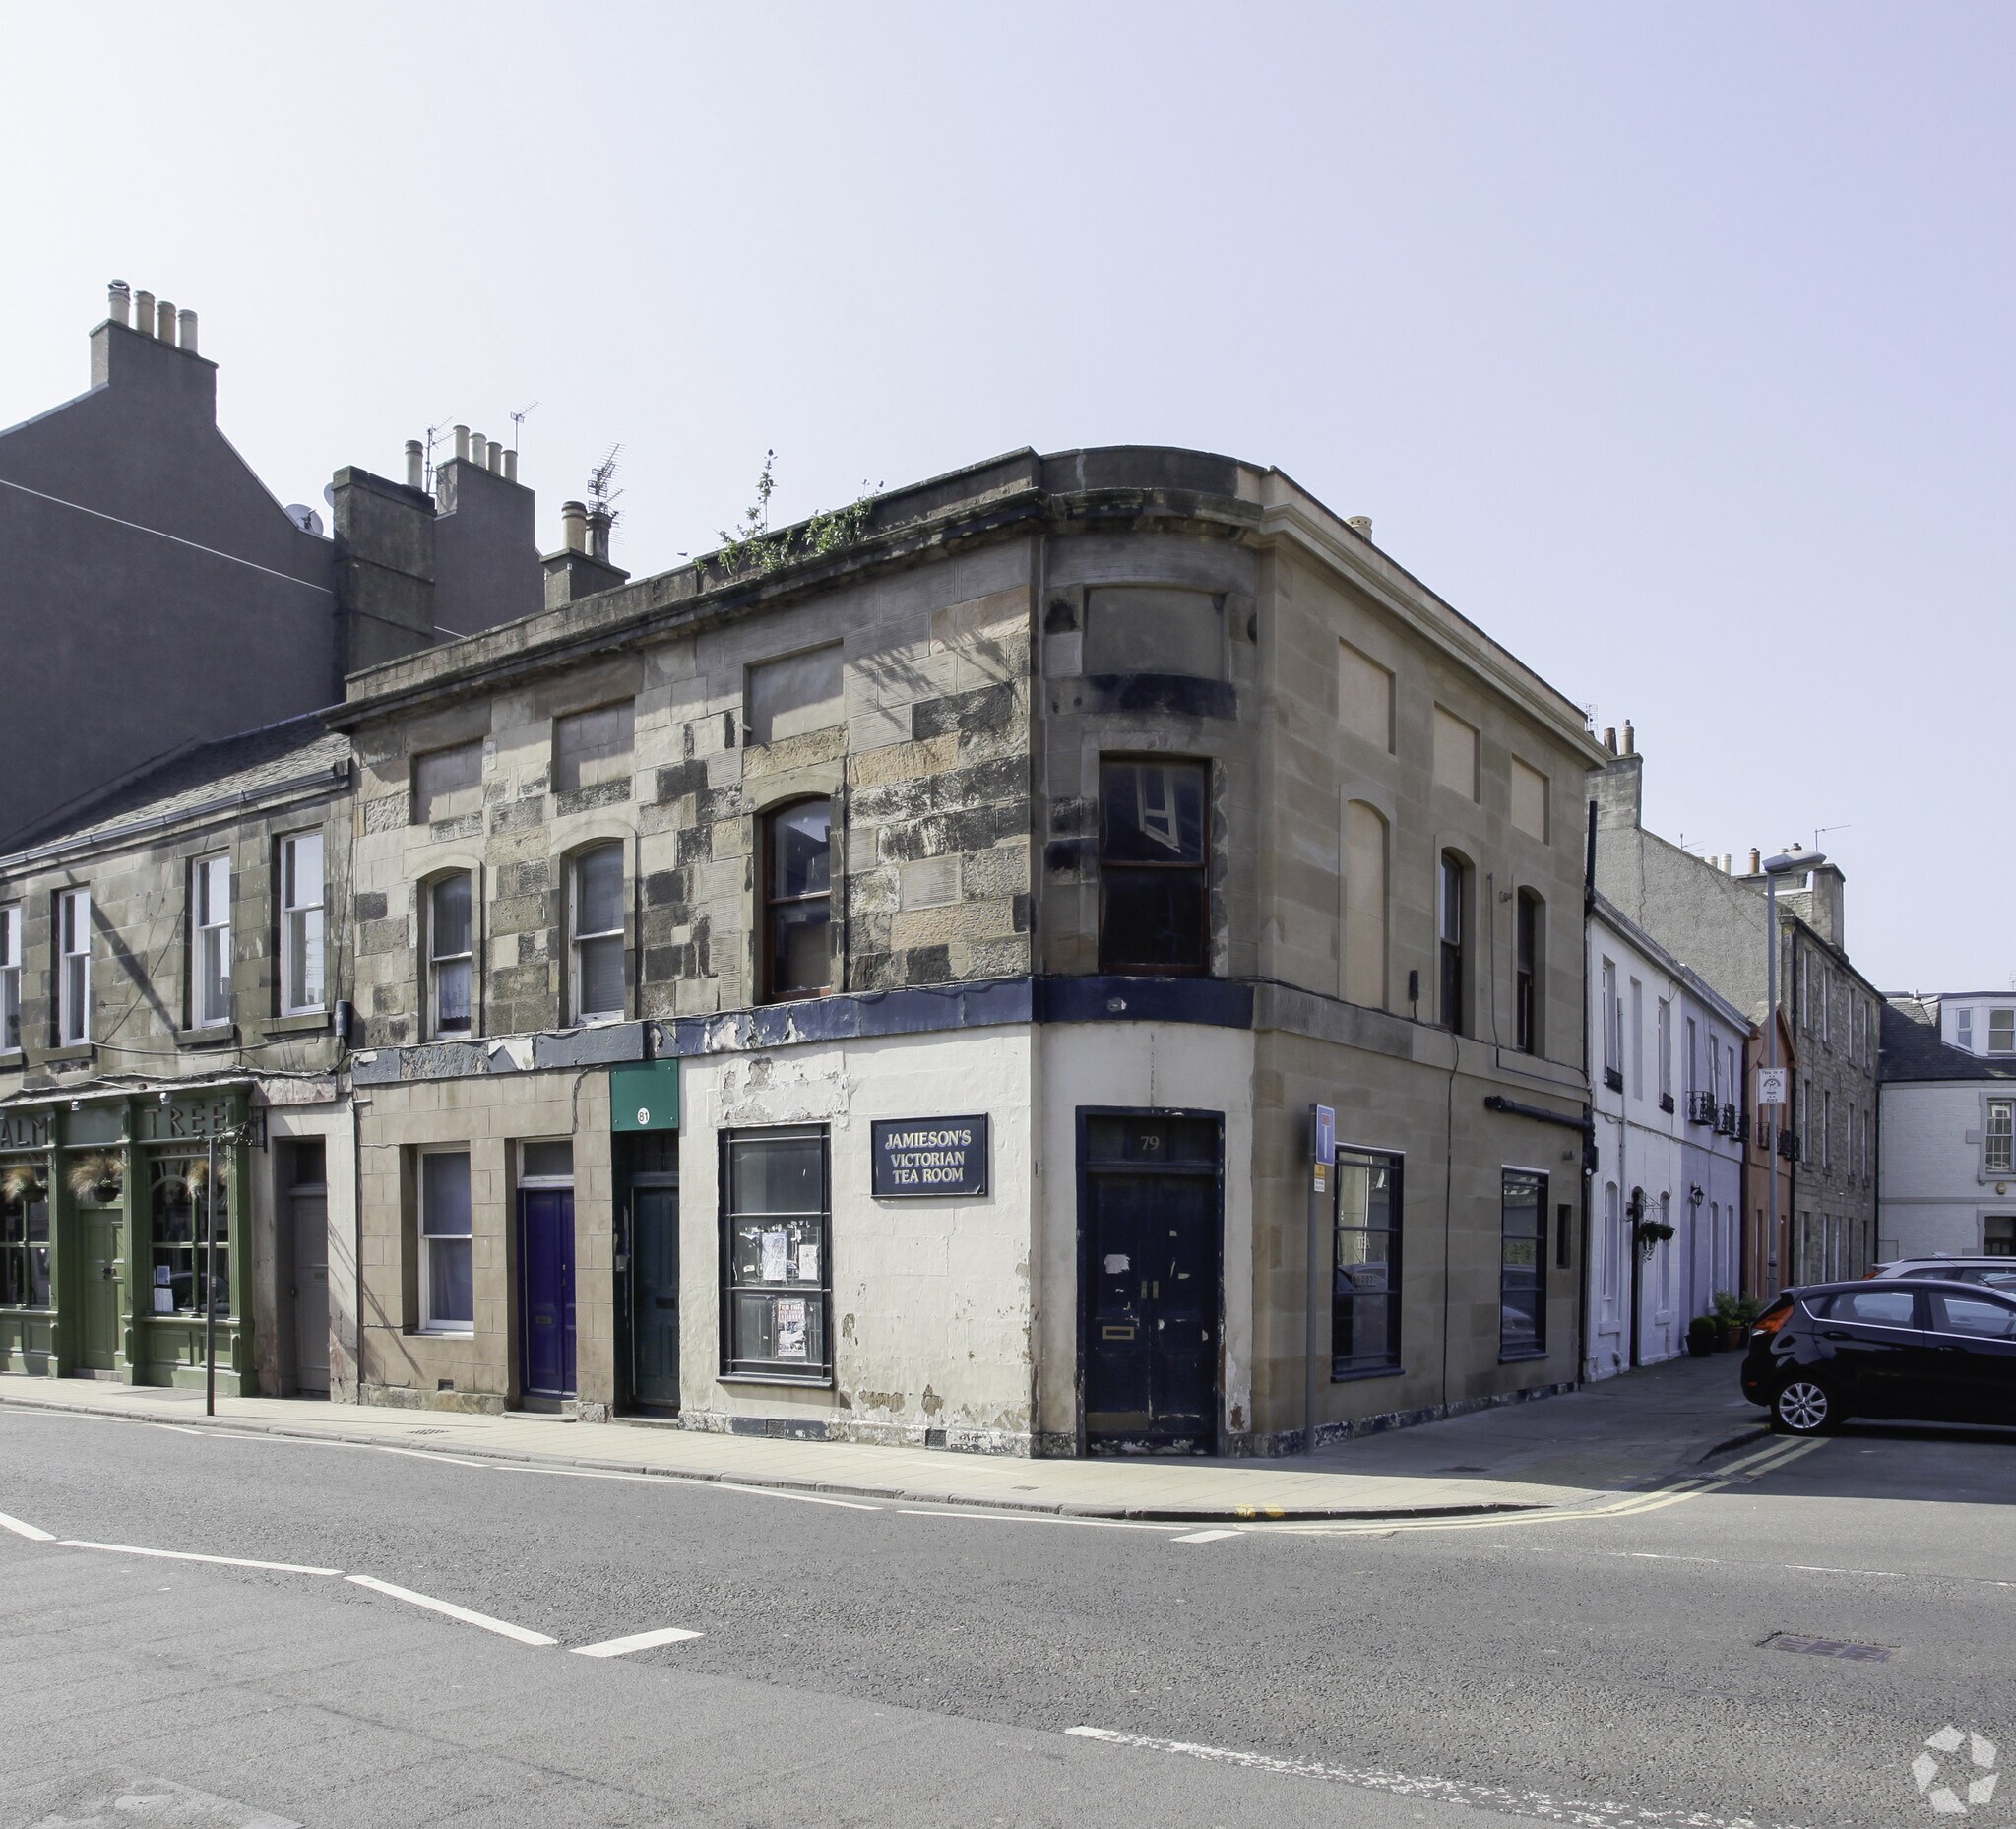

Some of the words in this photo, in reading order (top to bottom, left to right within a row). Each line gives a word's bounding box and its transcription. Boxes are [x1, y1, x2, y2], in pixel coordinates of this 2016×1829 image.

[144, 1102, 226, 1138] TREE
[639, 1112, 649, 1122] 81
[885, 1129, 972, 1150] JAMIESON'S
[1141, 1136, 1160, 1151] 79
[891, 1151, 965, 1167] VICTORIAN
[893, 1169, 918, 1184] TEA
[922, 1167, 964, 1183] ROOM
